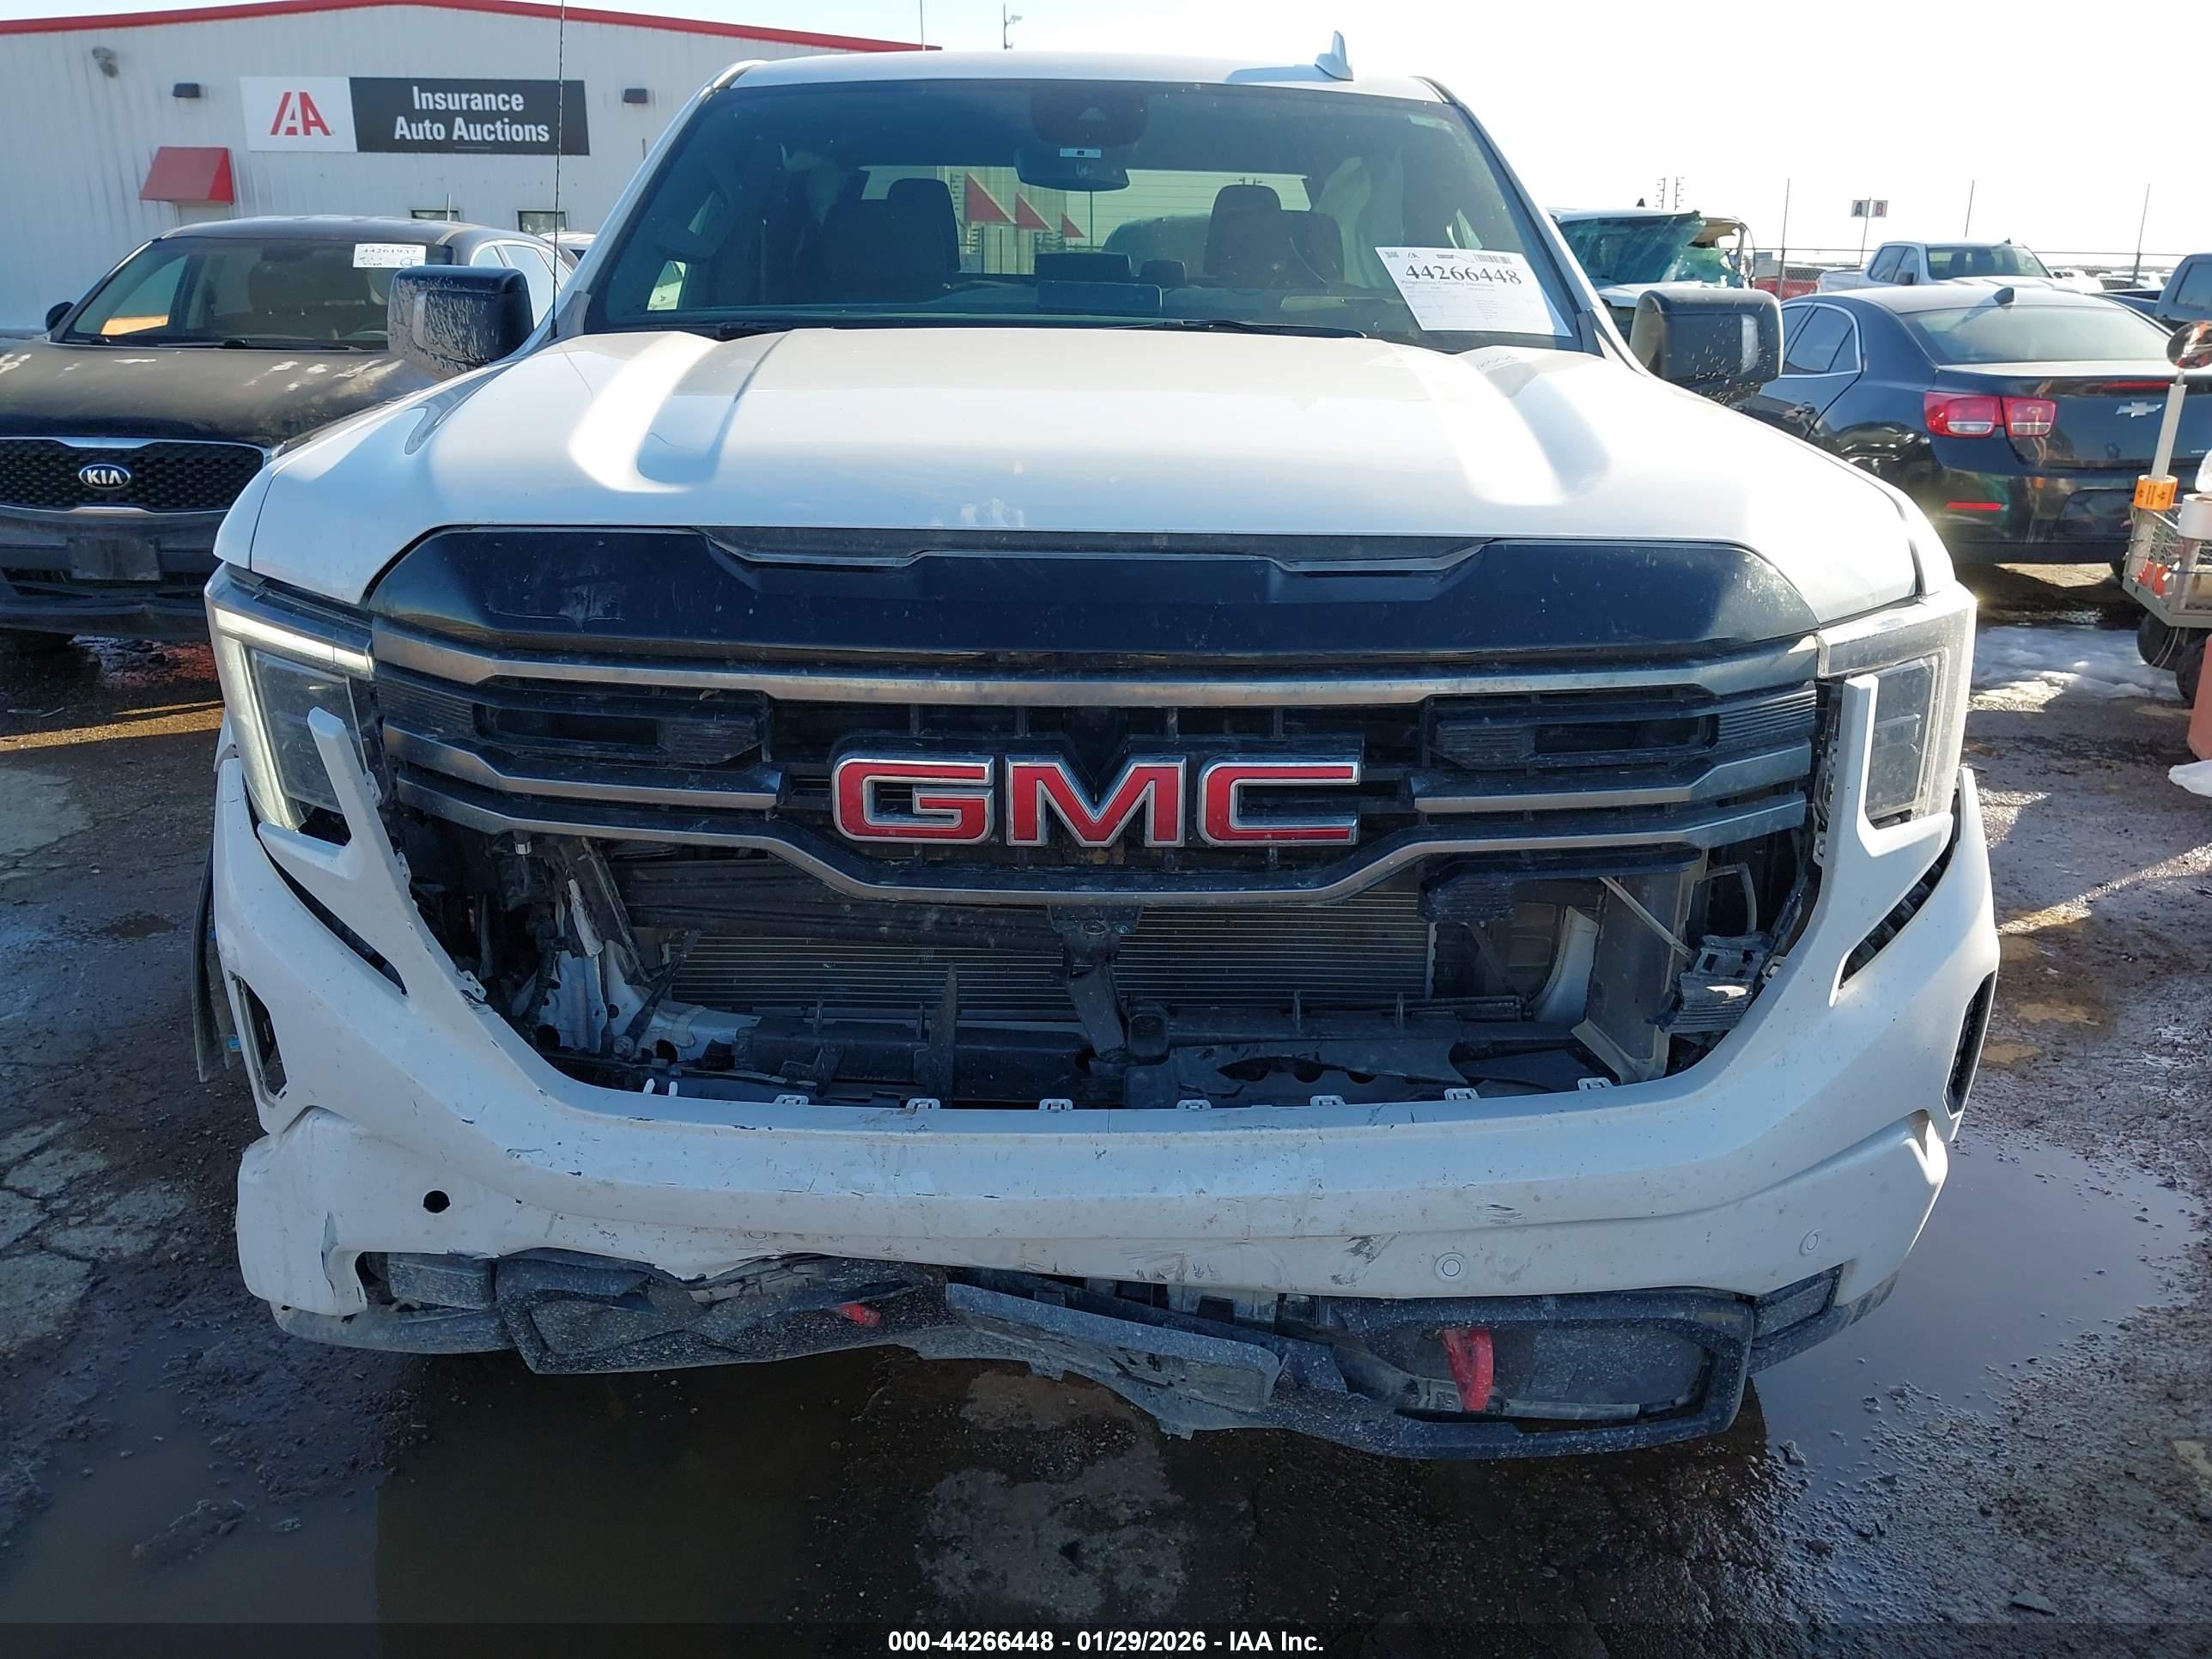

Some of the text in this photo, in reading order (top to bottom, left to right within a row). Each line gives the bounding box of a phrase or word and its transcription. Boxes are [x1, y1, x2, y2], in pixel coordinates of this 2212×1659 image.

[412, 86, 525, 112] Insurance
[394, 116, 550, 143] Auto Auctions
[1854, 202, 1863, 216] A
[1875, 202, 1884, 216] B
[1406, 264, 1522, 286] 44266448
[87, 469, 124, 484] KIA
[832, 754, 1361, 848] GMC
